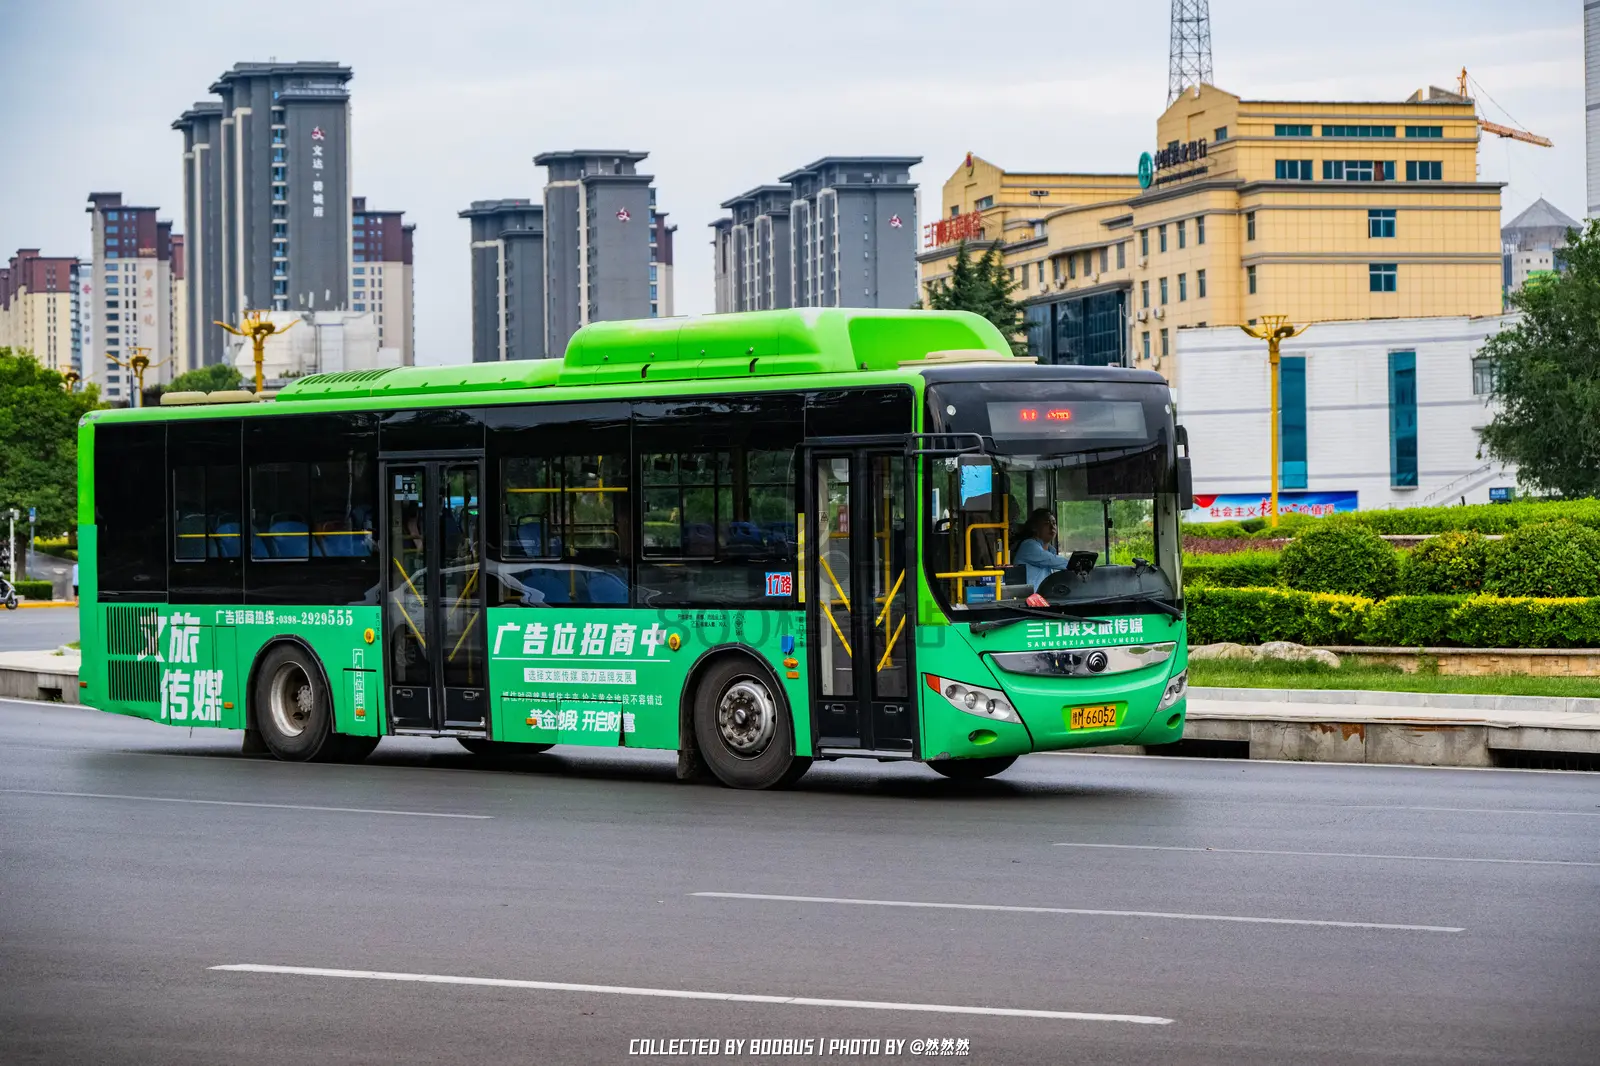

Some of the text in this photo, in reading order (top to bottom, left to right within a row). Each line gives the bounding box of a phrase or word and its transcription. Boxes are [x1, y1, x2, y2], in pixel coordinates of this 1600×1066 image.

[766, 574, 791, 595] 17路
[1026, 618, 1143, 638] 三门峡文旅传媒
[493, 622, 668, 657] 广告位招商中
[1027, 639, 1084, 648] SANMENXIA
[528, 670, 633, 683] 选择文旅传媒 助力品牌发展
[160, 668, 223, 722] 传媒
[581, 710, 636, 733] 开启财富
